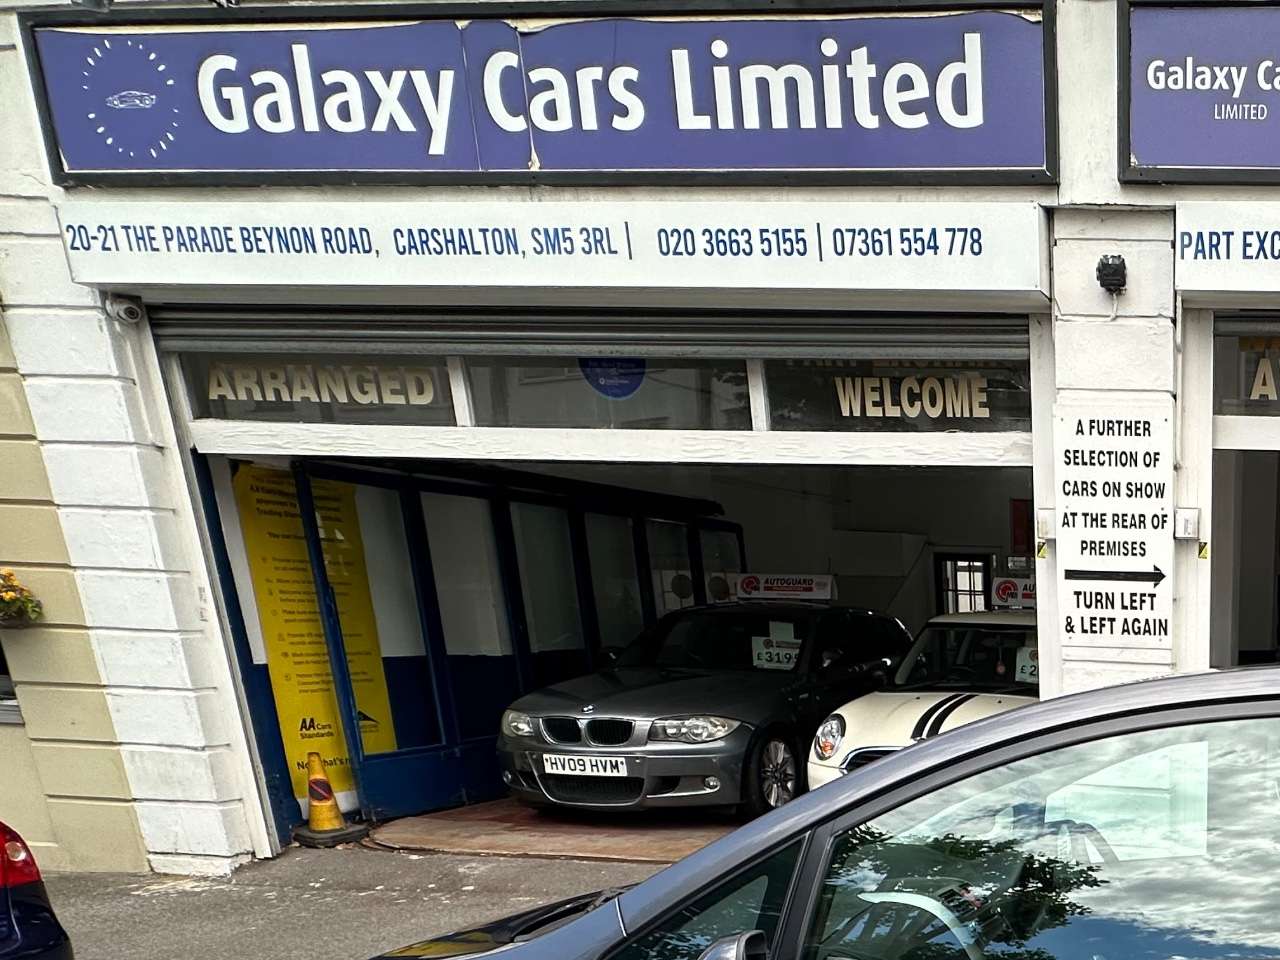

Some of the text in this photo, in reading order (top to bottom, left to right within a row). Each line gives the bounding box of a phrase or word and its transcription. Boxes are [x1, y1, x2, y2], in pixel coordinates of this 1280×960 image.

[1147, 57, 1247, 98] Galaxy
[197, 33, 984, 155] Galaxy Cars Limited
[1214, 104, 1268, 120] LIMITED
[66, 224, 618, 258] 20-21 THE PARADE BEYNON ROAD, CARSHALTON, SM5 3RL
[657, 228, 808, 256] 020 3663 5155
[832, 228, 983, 256] 07361 554 778
[1179, 231, 1235, 261] PART
[208, 361, 435, 406] ARRANGED
[834, 376, 990, 418] WELCOME
[1075, 419, 1151, 437] A FURTHER
[1064, 449, 1160, 468] SELECTION OF
[1062, 480, 1166, 499] CARS ON SHOW
[1062, 512, 1168, 530] AT THE REAR OF
[1080, 540, 1147, 557] PREMISES
[1074, 591, 1157, 611] TURN LEFT
[1065, 616, 1168, 636] & LEFT AGAIN
[300, 718, 316, 732] AA
[549, 756, 620, 774] HV09 HVM
